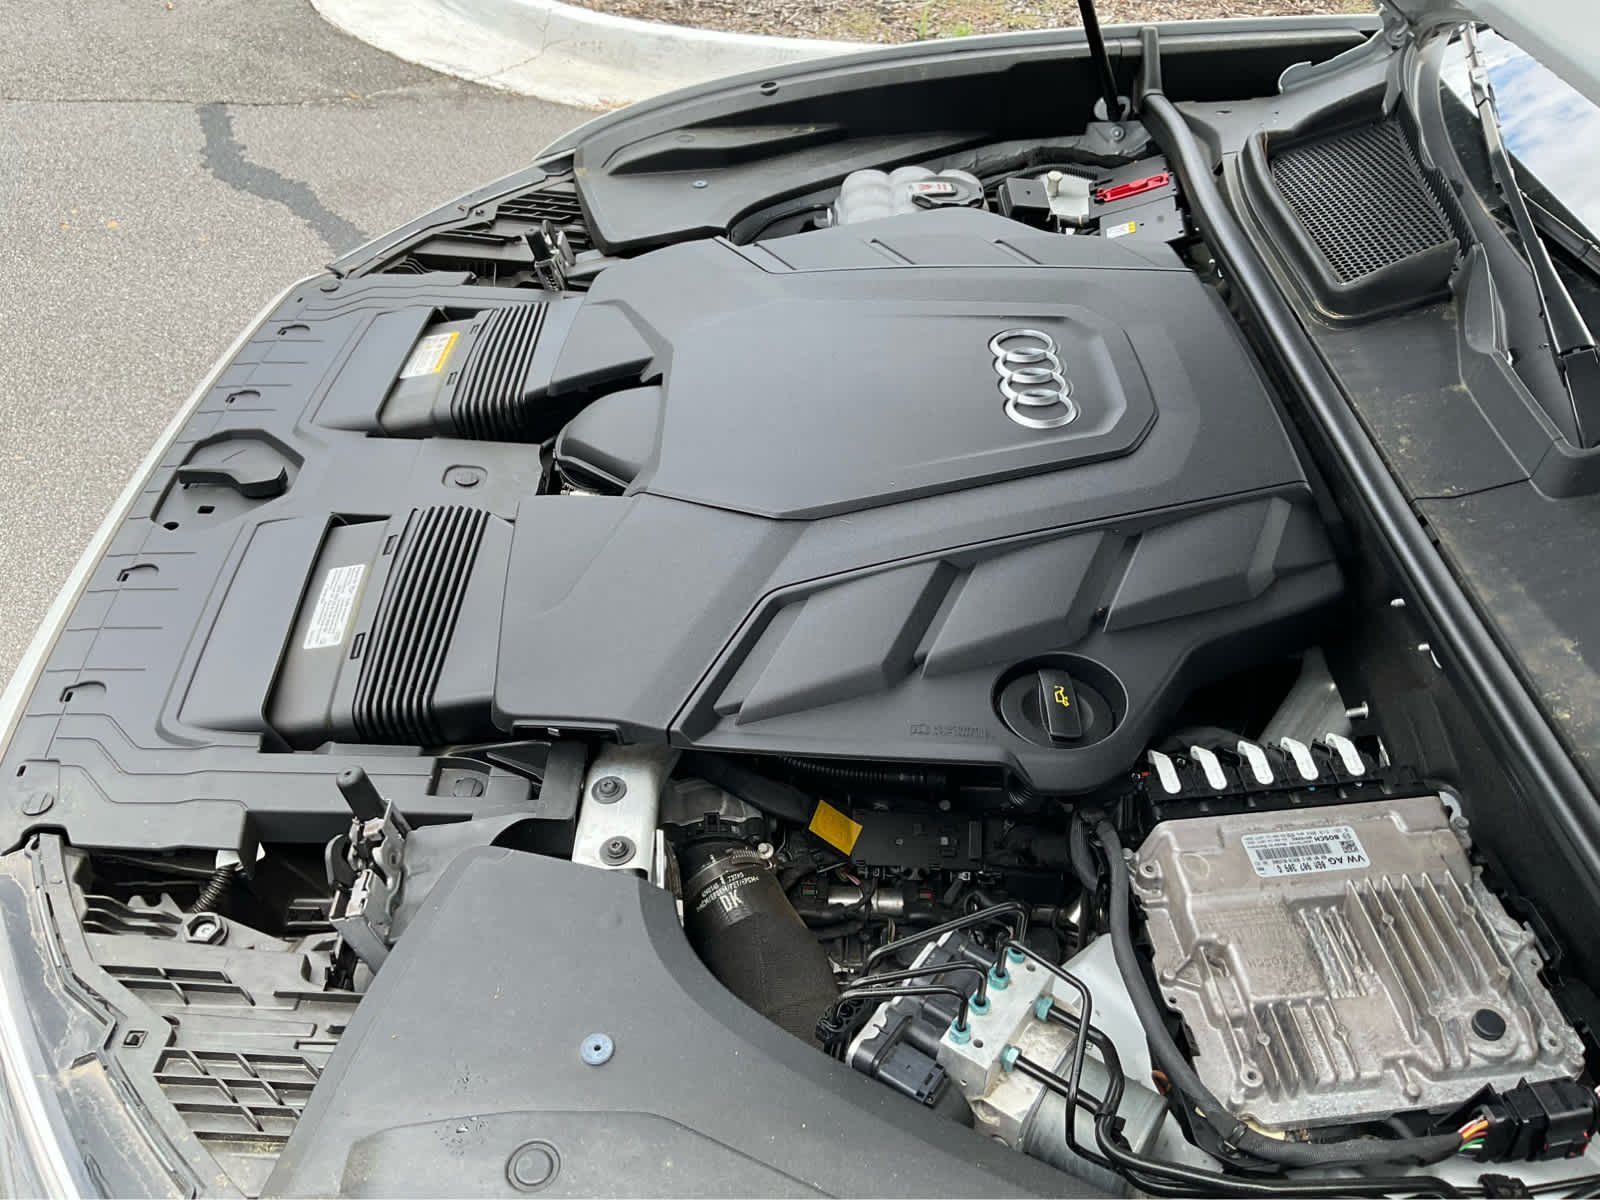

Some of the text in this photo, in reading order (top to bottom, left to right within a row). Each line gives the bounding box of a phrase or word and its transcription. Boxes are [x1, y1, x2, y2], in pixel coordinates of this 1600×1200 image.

[1313, 834, 1340, 842] BOSCH
[1327, 856, 1343, 865] AG
[1347, 854, 1366, 863] VW
[719, 889, 744, 912] DK
